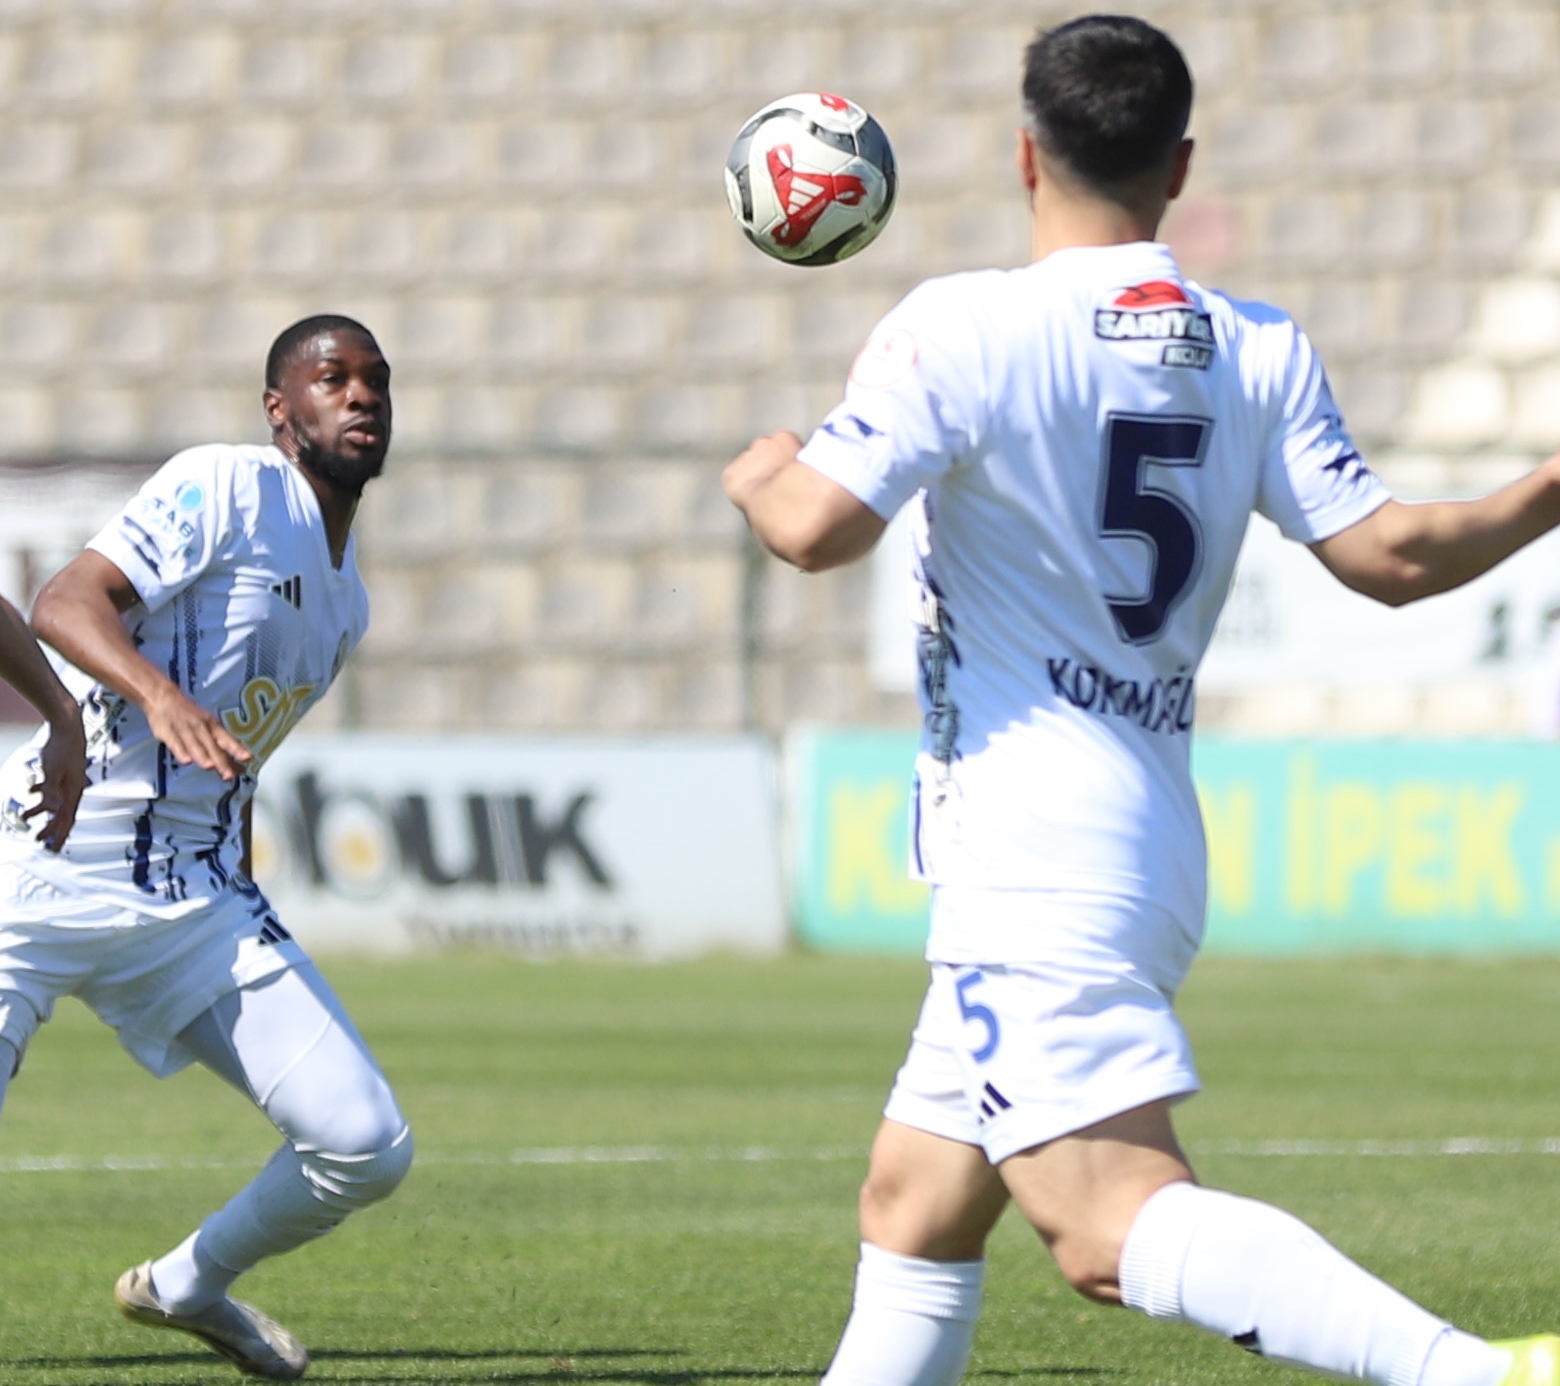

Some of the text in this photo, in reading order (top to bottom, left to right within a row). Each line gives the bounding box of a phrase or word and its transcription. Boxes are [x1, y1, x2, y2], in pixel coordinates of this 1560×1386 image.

[1098, 412, 1217, 647] 5
[1288, 758, 1528, 919] İPEK
[955, 970, 1001, 1064] 5
